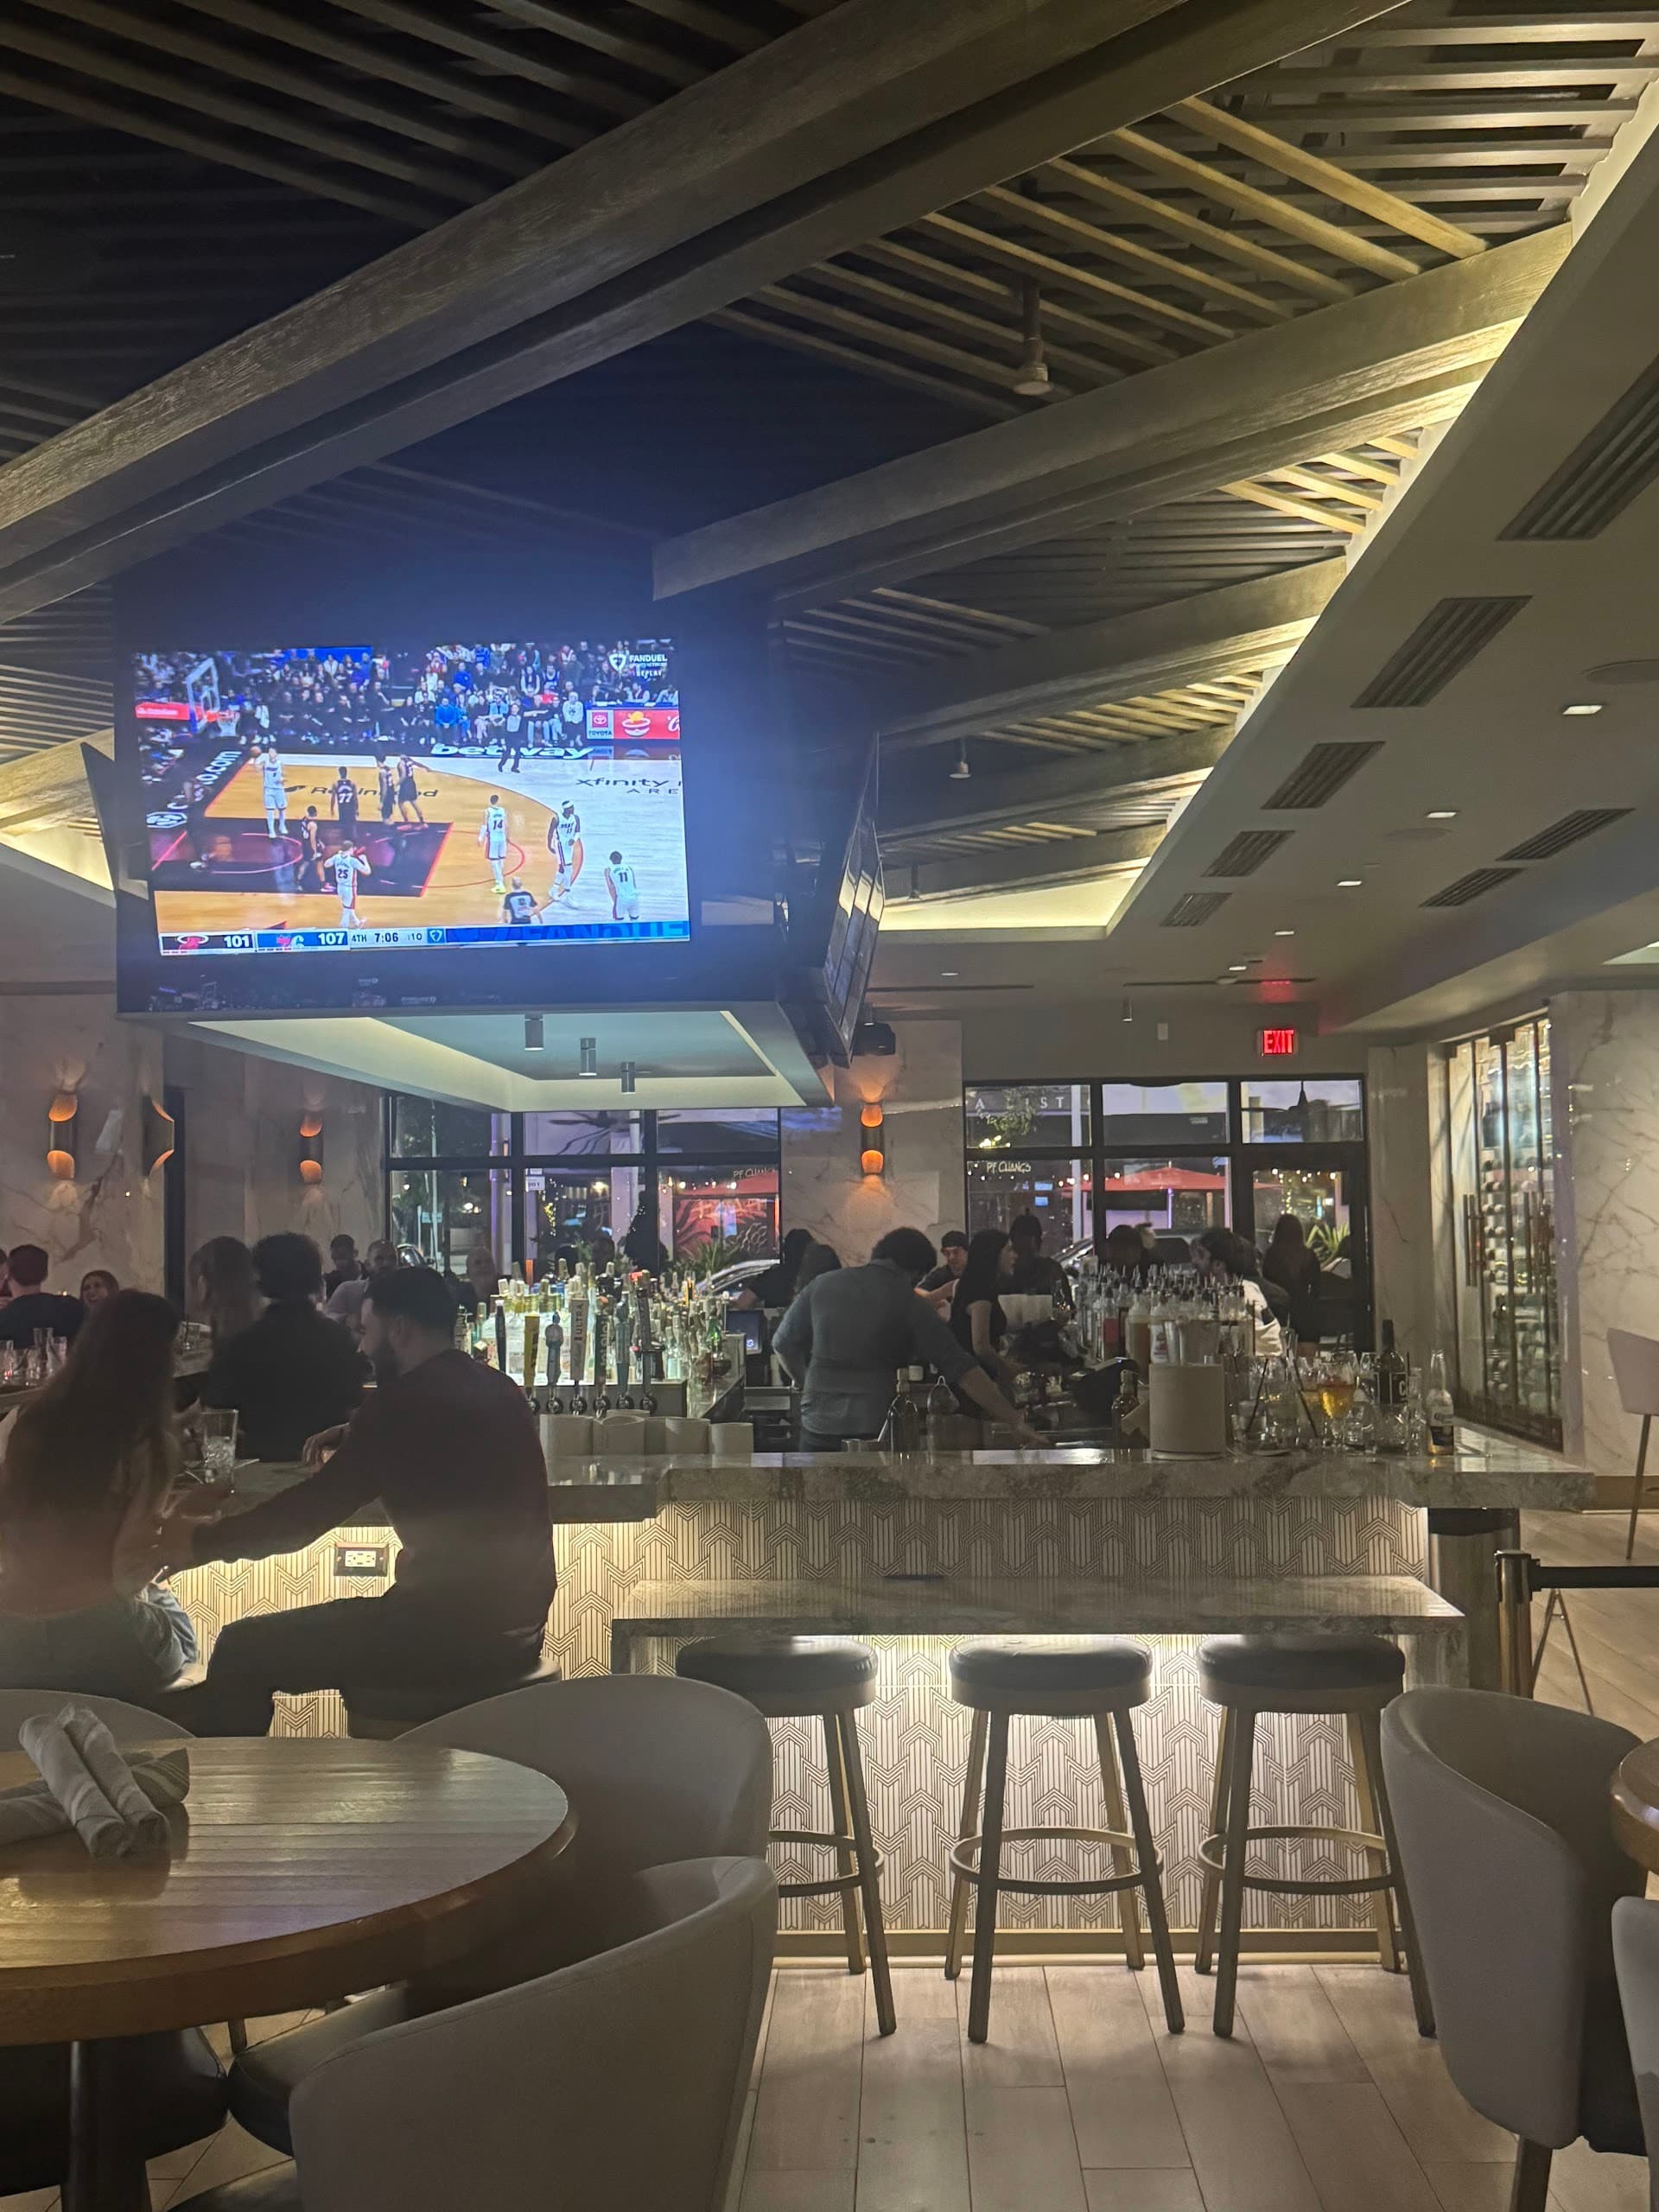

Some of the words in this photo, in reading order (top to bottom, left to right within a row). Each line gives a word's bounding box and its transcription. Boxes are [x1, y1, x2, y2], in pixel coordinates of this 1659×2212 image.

[628, 653, 668, 663] FANDUEL
[575, 777, 670, 788] xfinity
[339, 792, 353, 804] 77
[493, 819, 504, 830] 14
[338, 868, 349, 880] 25
[619, 872, 629, 883] 11
[224, 935, 250, 948] 101
[318, 932, 346, 946] 107
[351, 934, 367, 944] 4TH
[374, 932, 399, 944] 7:06
[1263, 1029, 1294, 1054] EXIT
[575, 1302, 585, 1333] ULTRA
